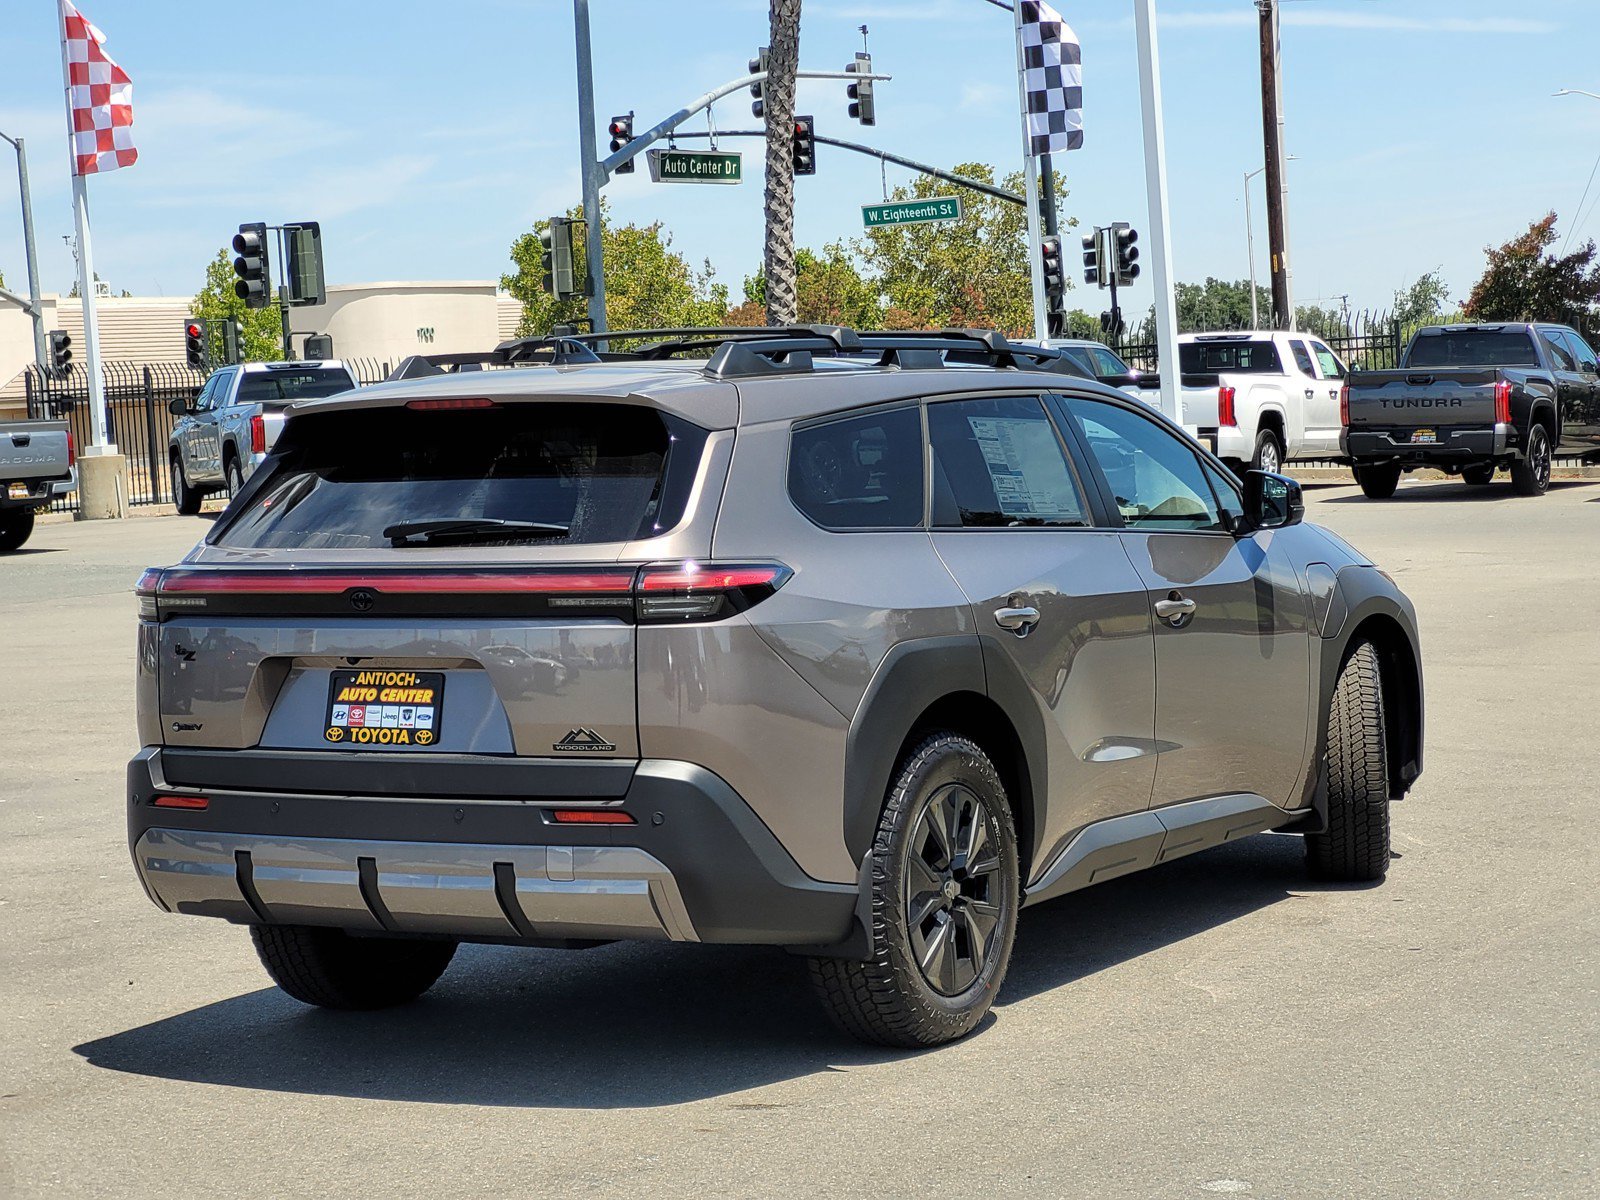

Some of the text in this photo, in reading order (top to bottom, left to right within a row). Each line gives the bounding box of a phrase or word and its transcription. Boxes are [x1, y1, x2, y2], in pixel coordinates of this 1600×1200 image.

[664, 159, 737, 175] Auto Center Dr
[868, 204, 952, 222] W. Eighteenth St
[1379, 399, 1462, 408] TUNDRA
[356, 672, 415, 686] ANTIOCH
[337, 687, 434, 703] AUTO CENTER
[383, 713, 398, 721] Jeep
[350, 728, 410, 744] TOYOTA
